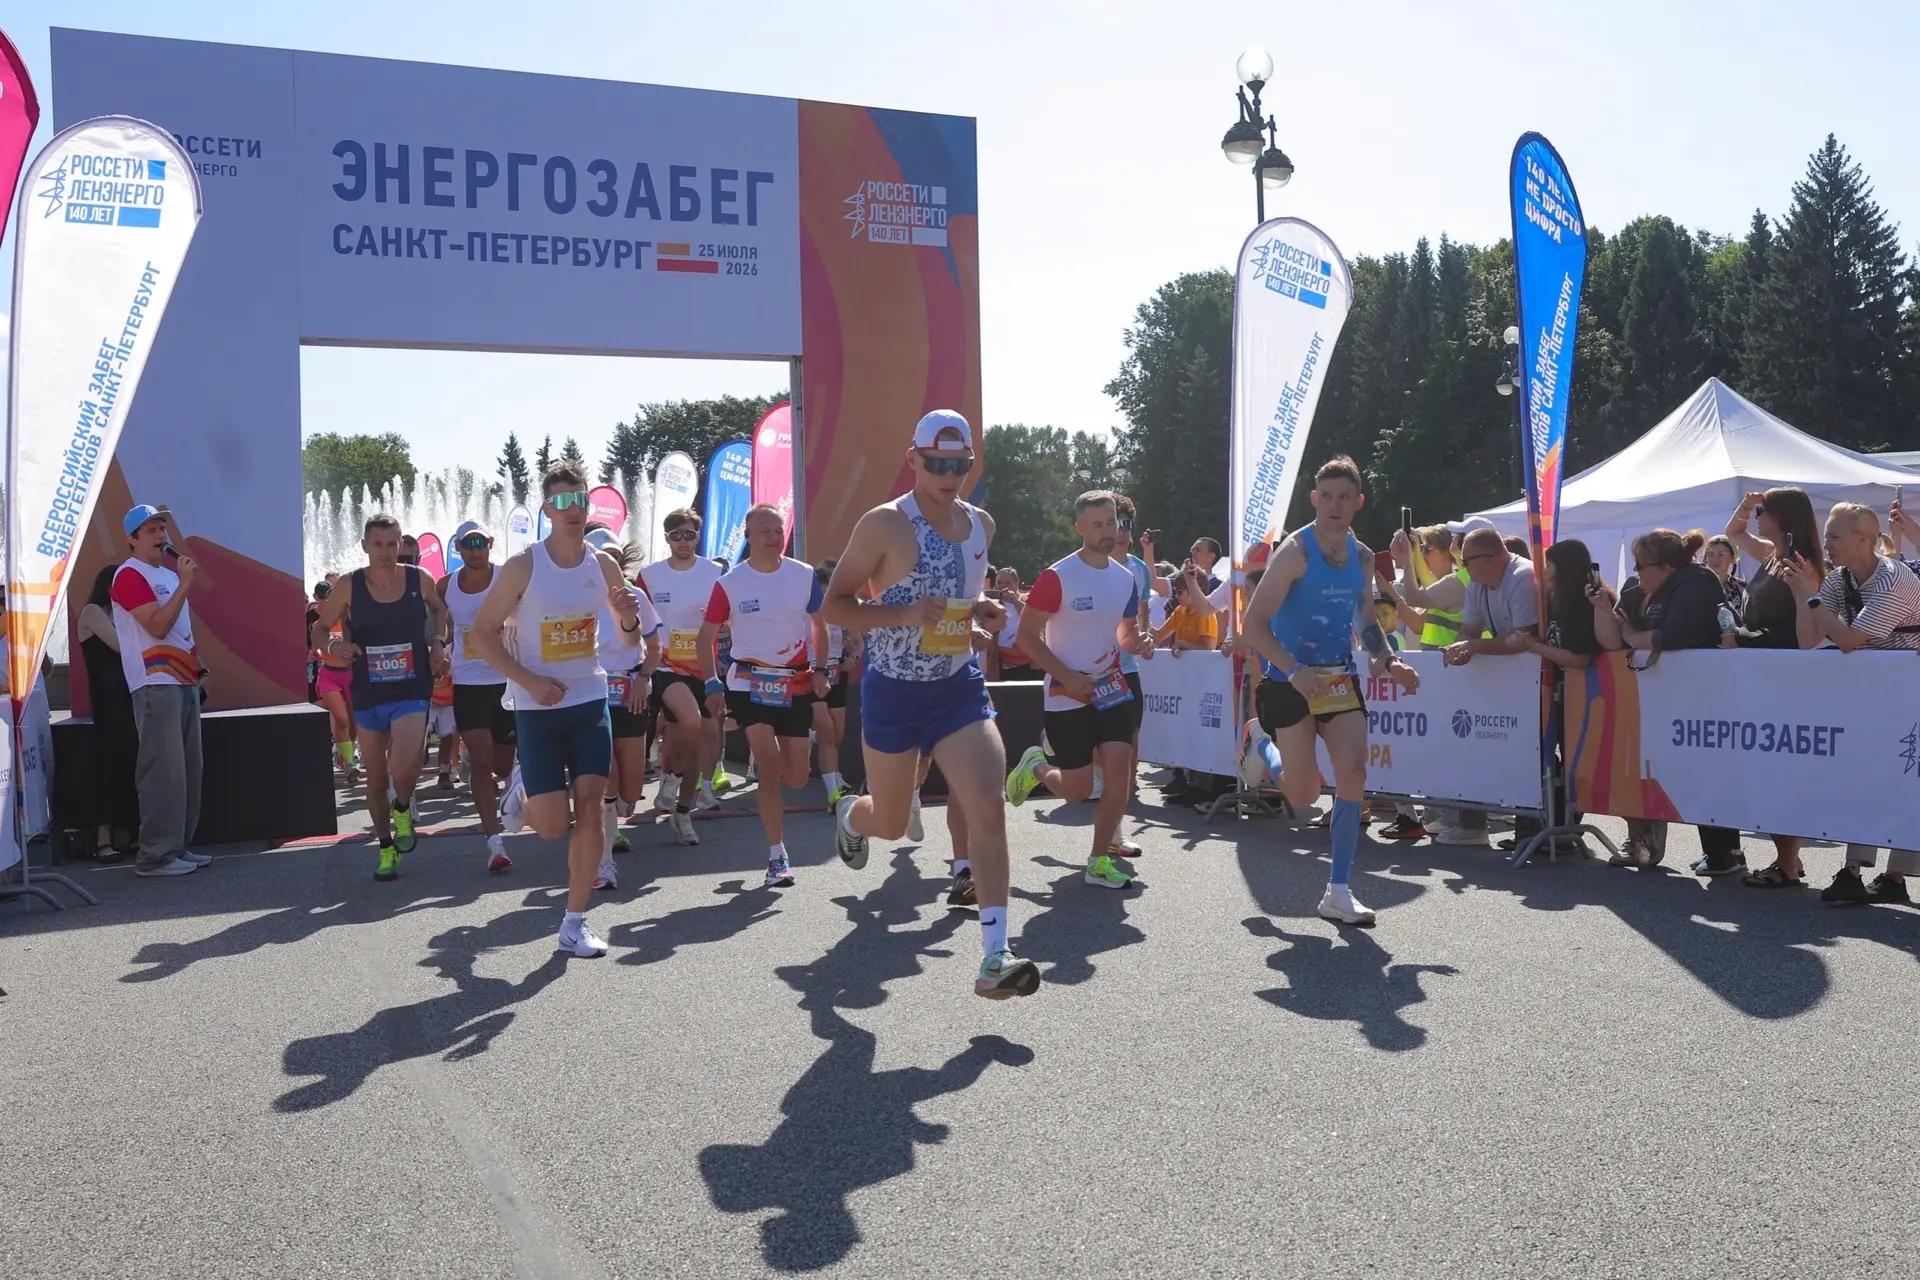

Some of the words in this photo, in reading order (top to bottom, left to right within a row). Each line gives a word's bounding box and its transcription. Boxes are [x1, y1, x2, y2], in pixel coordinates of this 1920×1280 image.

[71, 154, 144, 180] РОССЕТИ
[1526, 156, 1545, 185] 140
[67, 179, 164, 206] ЛЕНЭНЕРГО
[332, 139, 774, 227] ЭНЕРГОЗАБЕГ
[867, 181, 928, 204] РОССЕТИ
[69, 206, 88, 221] 140
[89, 207, 113, 222] ЛЕТ
[868, 203, 947, 228] ЛЕНЭНЕРГО
[1526, 177, 1540, 202] НЕ
[1542, 192, 1581, 236] ПРОСТО
[872, 228, 887, 240] 140
[889, 229, 907, 241] ЛЕТ
[1525, 198, 1561, 245] ЦИФРА
[333, 223, 652, 270] САНКТ-ПЕТЕРБУРГ
[698, 244, 715, 257] 25
[718, 245, 758, 260] ИЮЛЯ
[1272, 239, 1319, 273] РОССЕТИ
[726, 262, 758, 276] 2026
[1268, 258, 1330, 294] ЛЕНЭНЕРГО
[1536, 326, 1552, 378] ЗАБЕГ
[1542, 272, 1574, 409] САНКТ-ПЕТЕРБУРГ
[1274, 381, 1295, 426] ЗАБЕГ
[1279, 331, 1324, 451] САНКТ-ПЕТЕРБУРГ
[54, 434, 102, 560] ЭНЕРГЕТИКОВ
[94, 261, 160, 428] САНКТ-ПЕТЕРБУРГ
[36, 400, 98, 558] ВСЕРОССИЙСКИЙ
[88, 336, 116, 395] ЗАБЕГ
[550, 629, 588, 645] 5132
[676, 640, 697, 649] 512
[376, 658, 407, 670] 1005
[758, 682, 787, 693] 1054
[1094, 681, 1121, 697] 1018
[1366, 677, 1398, 701] ЛЕТ
[1368, 710, 1428, 737] РОСТО
[1474, 714, 1518, 728] РОССЕТИ
[1672, 718, 1844, 757] ЭНЕРГОЗАБЕГ
